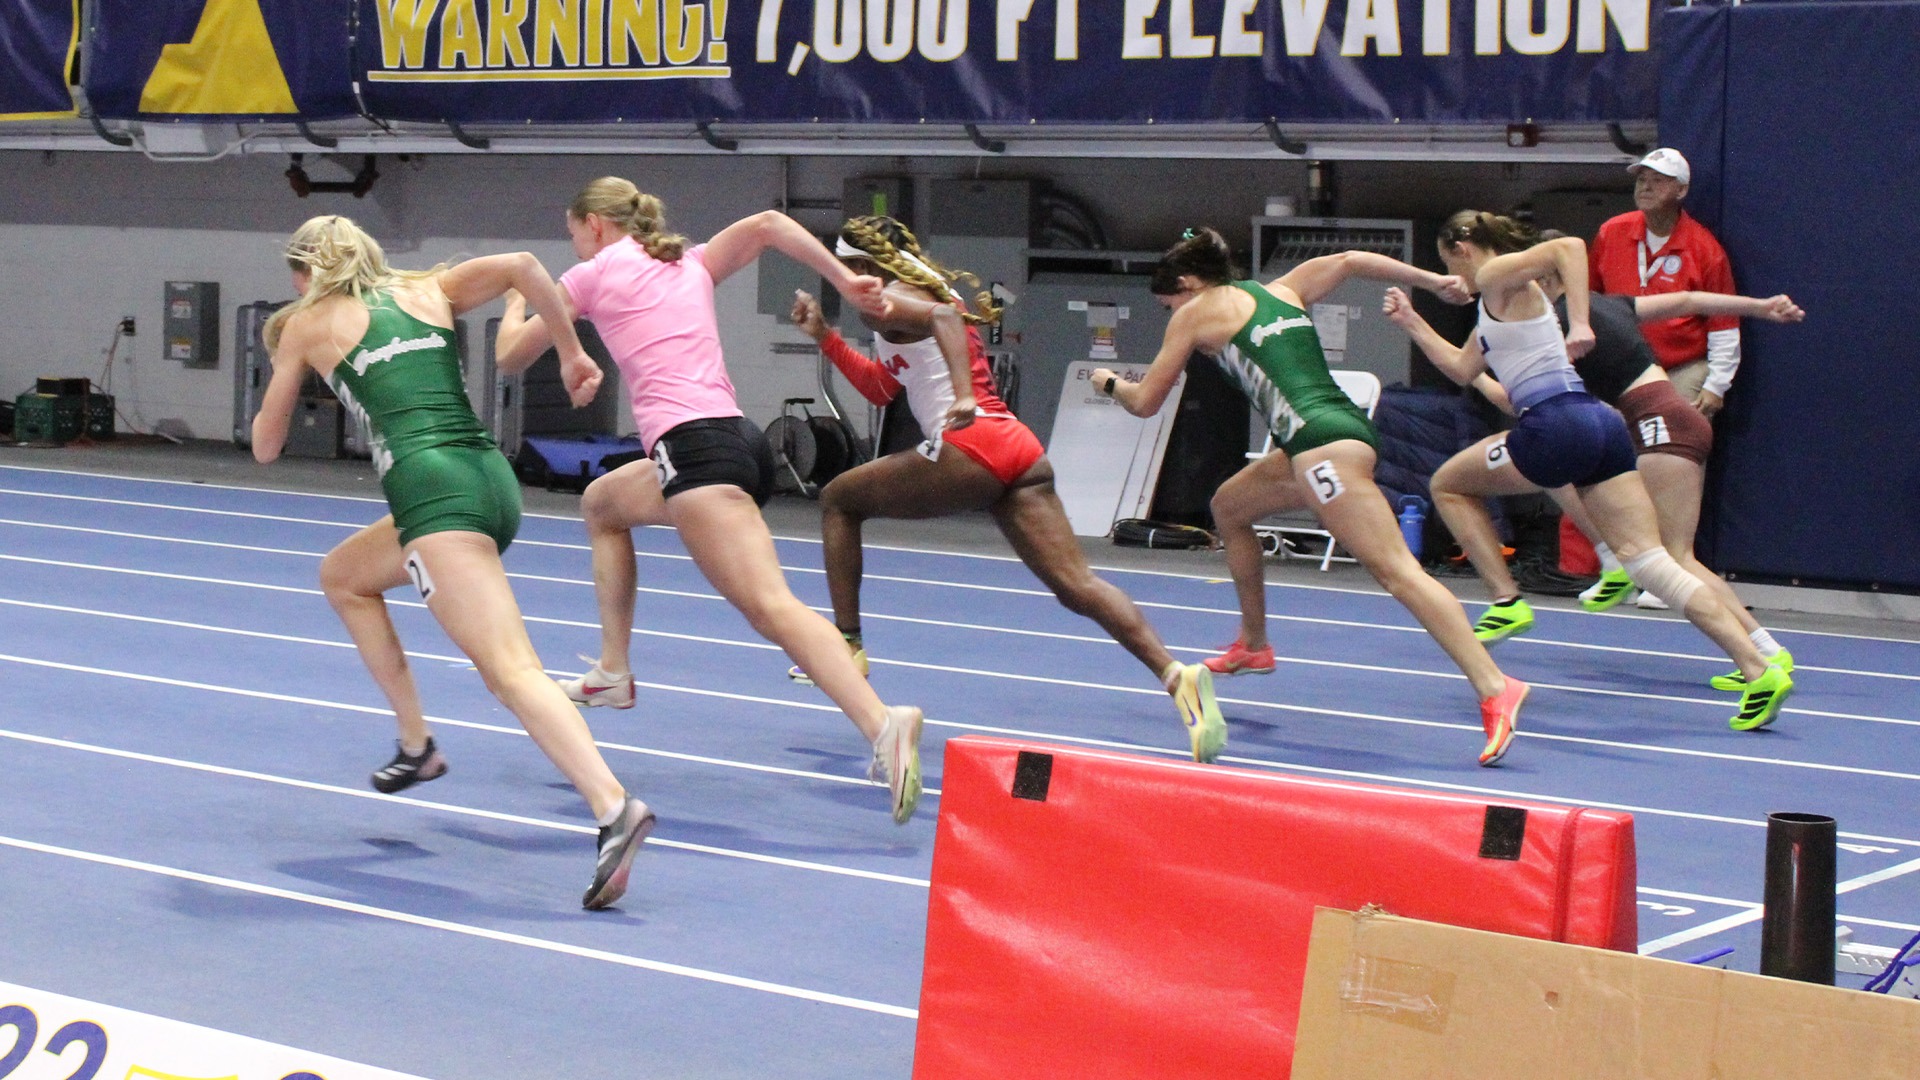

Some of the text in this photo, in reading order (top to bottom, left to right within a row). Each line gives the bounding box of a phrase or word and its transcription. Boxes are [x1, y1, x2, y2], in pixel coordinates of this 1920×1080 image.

[376, 0, 729, 69] WARNING!
[1121, 0, 1651, 60] ELEVATION
[1645, 419, 1659, 445] 7
[1488, 444, 1507, 462] 6
[1312, 465, 1336, 499] 5
[409, 559, 431, 599] 2
